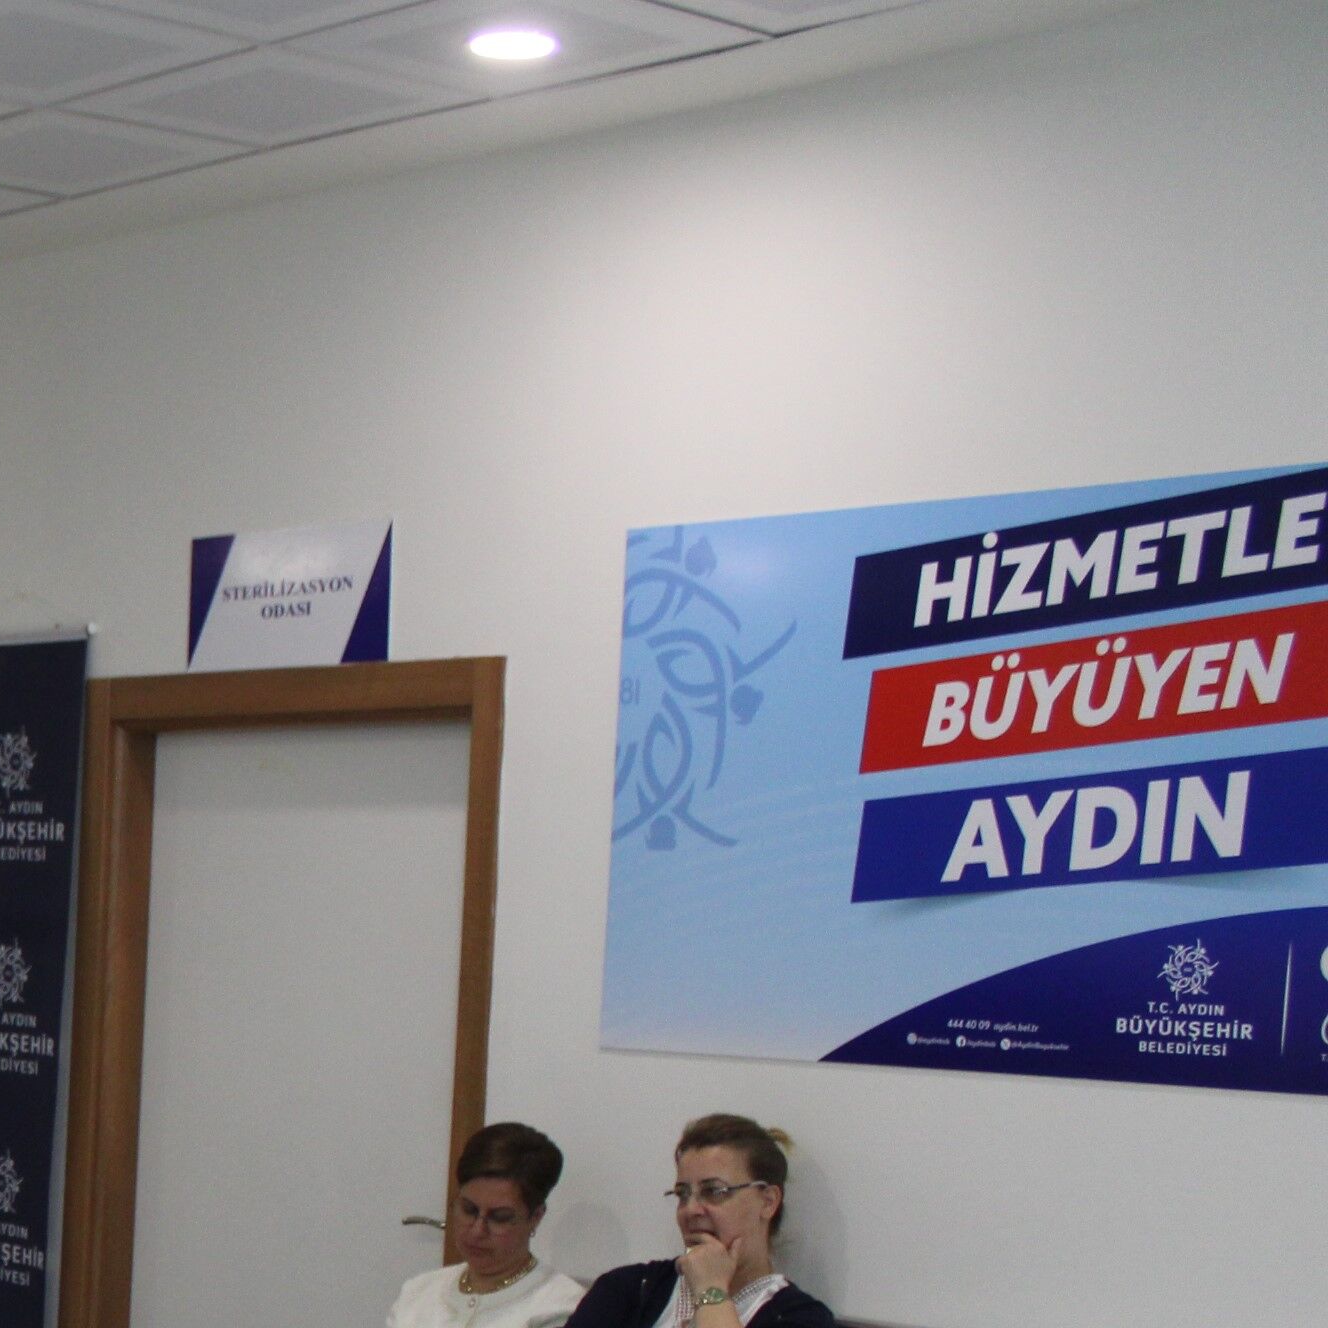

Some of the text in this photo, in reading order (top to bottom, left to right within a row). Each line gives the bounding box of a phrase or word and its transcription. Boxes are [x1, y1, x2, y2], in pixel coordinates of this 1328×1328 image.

[913, 491, 1328, 628] HİZMETLE
[222, 576, 353, 601] STERİLİZASYON
[261, 602, 311, 618] ODASI
[922, 632, 1296, 748] BÜYÜYEN
[9, 801, 43, 814] AYDIN
[941, 770, 1251, 883] AYDIN
[1147, 1001, 1225, 1016] T.C. AYDIN
[2, 1012, 36, 1028] AYDIN
[947, 1019, 963, 1029] 444
[965, 1020, 977, 1030] 40
[978, 1020, 990, 1030] 09
[1116, 1015, 1253, 1041] BÜYÜKŞEHİR
[1139, 1041, 1227, 1057] BELEDİYESİ
